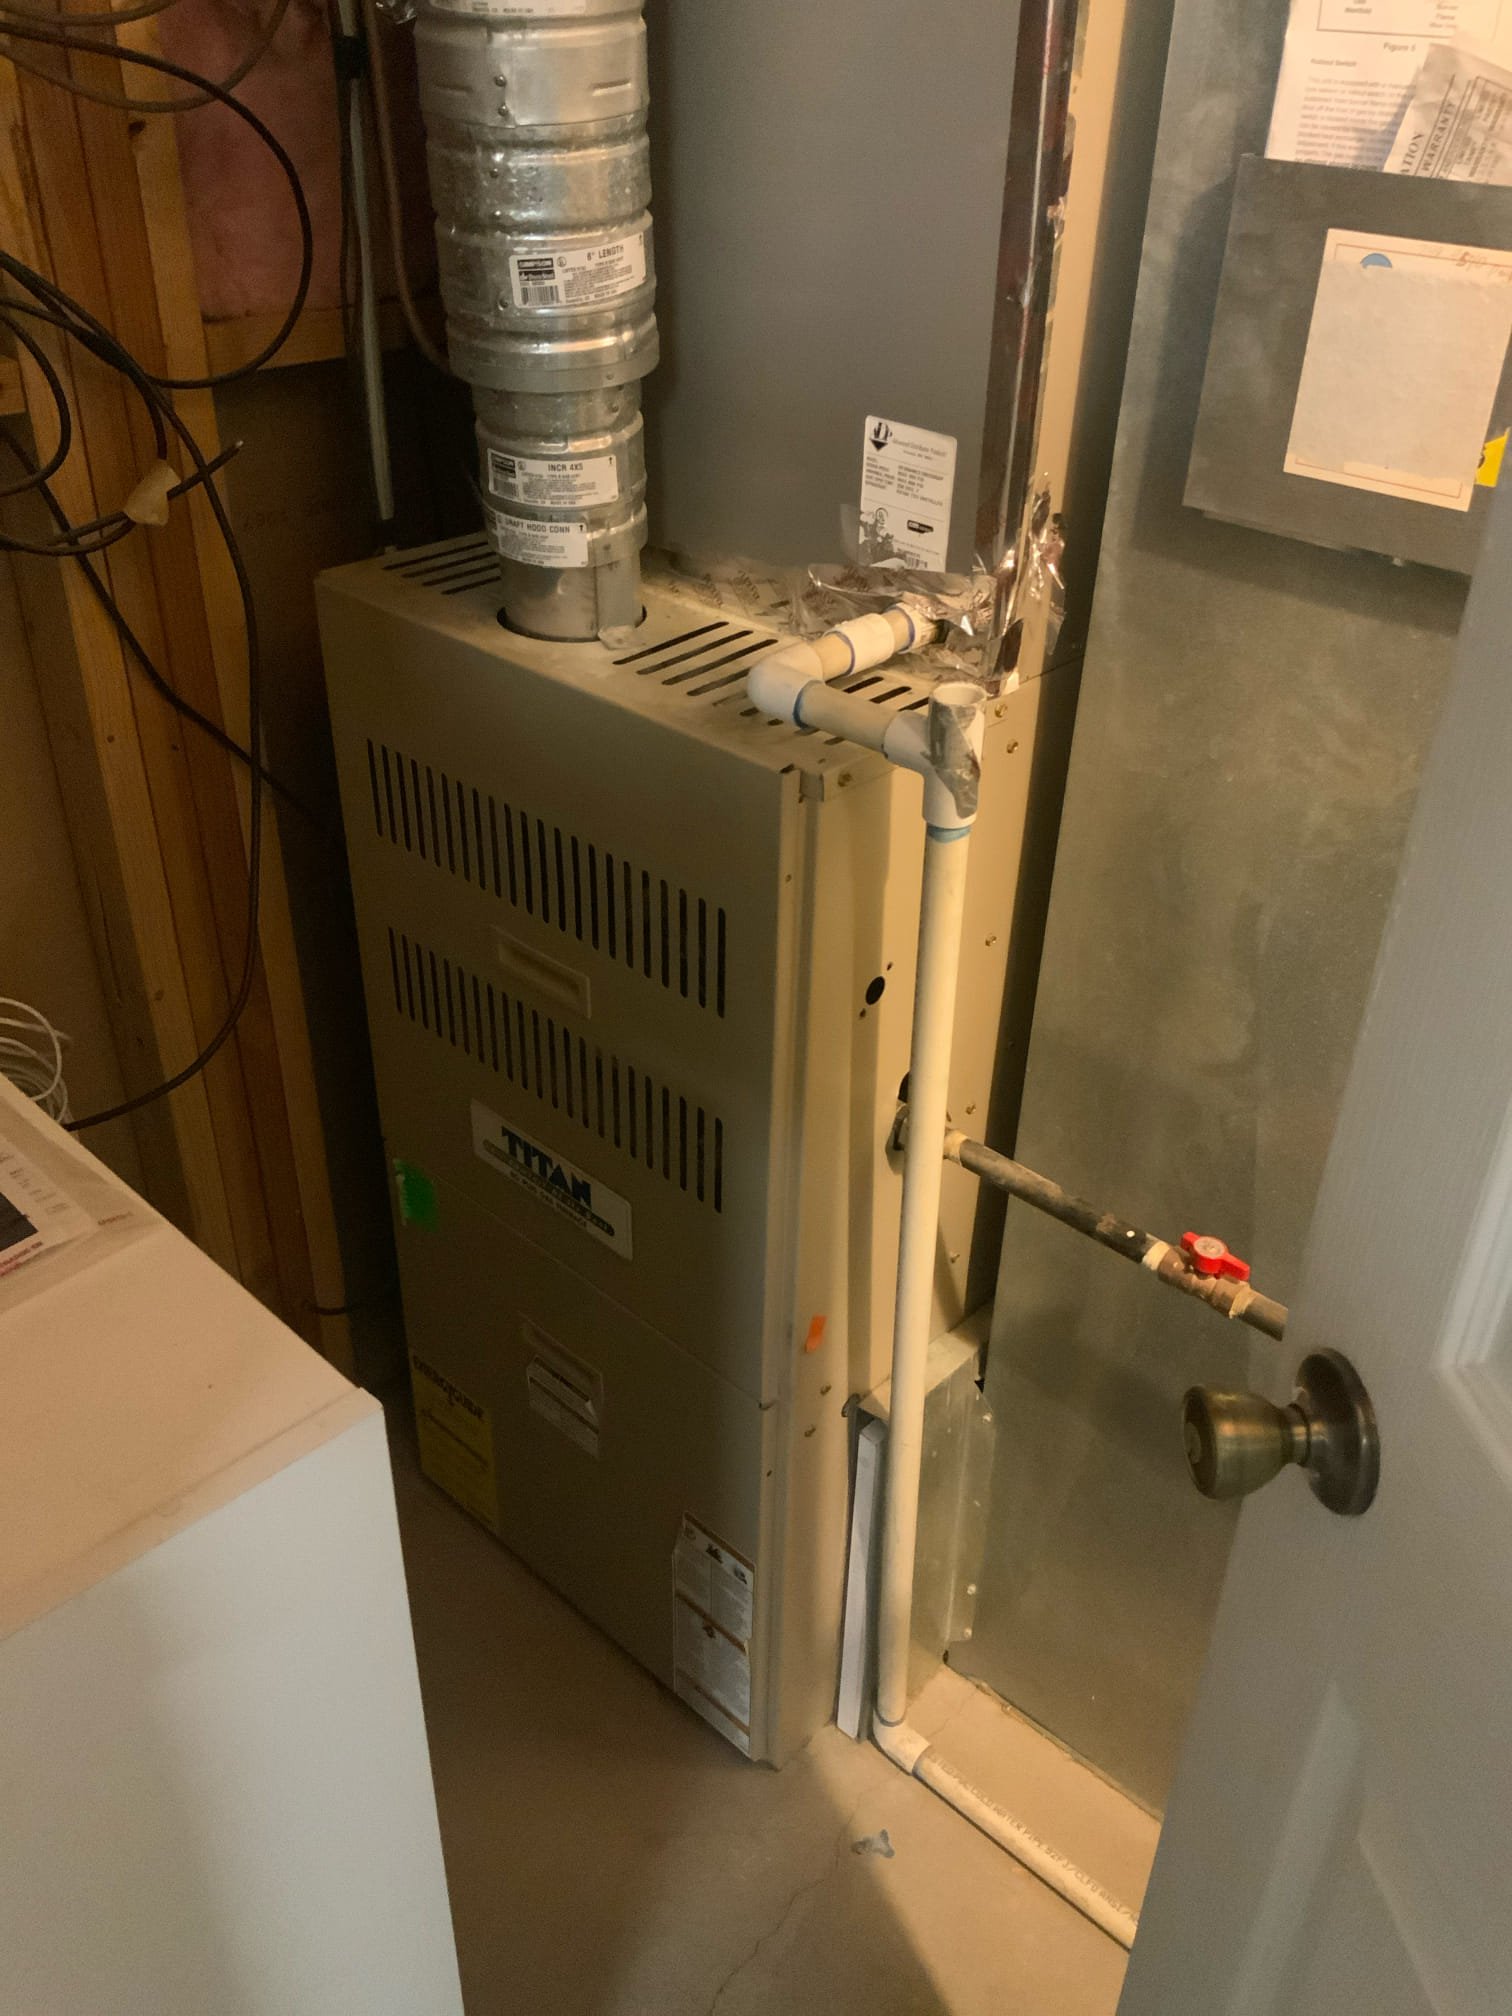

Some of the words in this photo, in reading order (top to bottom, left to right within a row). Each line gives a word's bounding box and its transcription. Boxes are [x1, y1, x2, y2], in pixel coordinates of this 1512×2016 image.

[1384, 42, 1409, 52] Figure
[1422, 100, 1456, 171] WARRANTY
[598, 244, 625, 260] LENGTH
[548, 463, 567, 472] INCR
[526, 523, 547, 533] HOOD
[549, 525, 570, 534] CONN
[501, 1126, 592, 1210] TITAN
